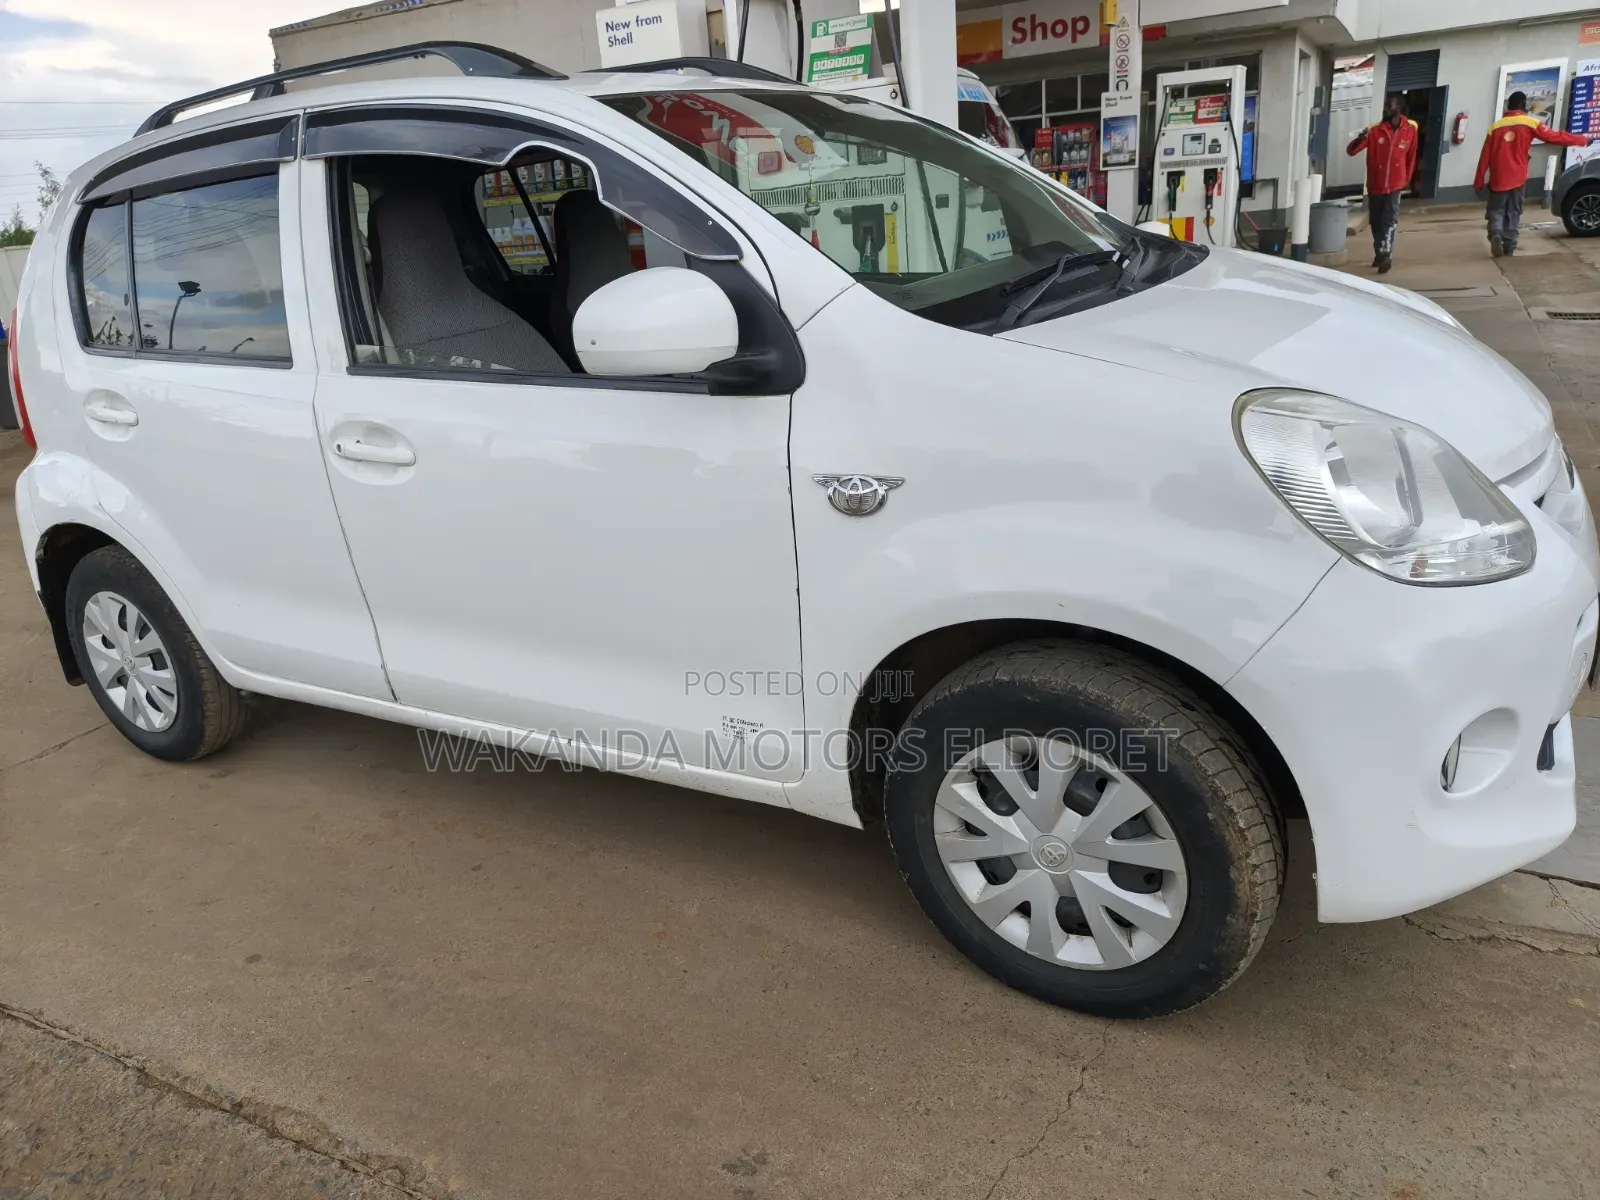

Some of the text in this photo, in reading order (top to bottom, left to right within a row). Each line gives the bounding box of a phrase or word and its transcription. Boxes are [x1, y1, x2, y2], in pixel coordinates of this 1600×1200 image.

[605, 15, 662, 33] New from
[1012, 14, 1090, 44] Shop
[608, 32, 633, 47] Shell
